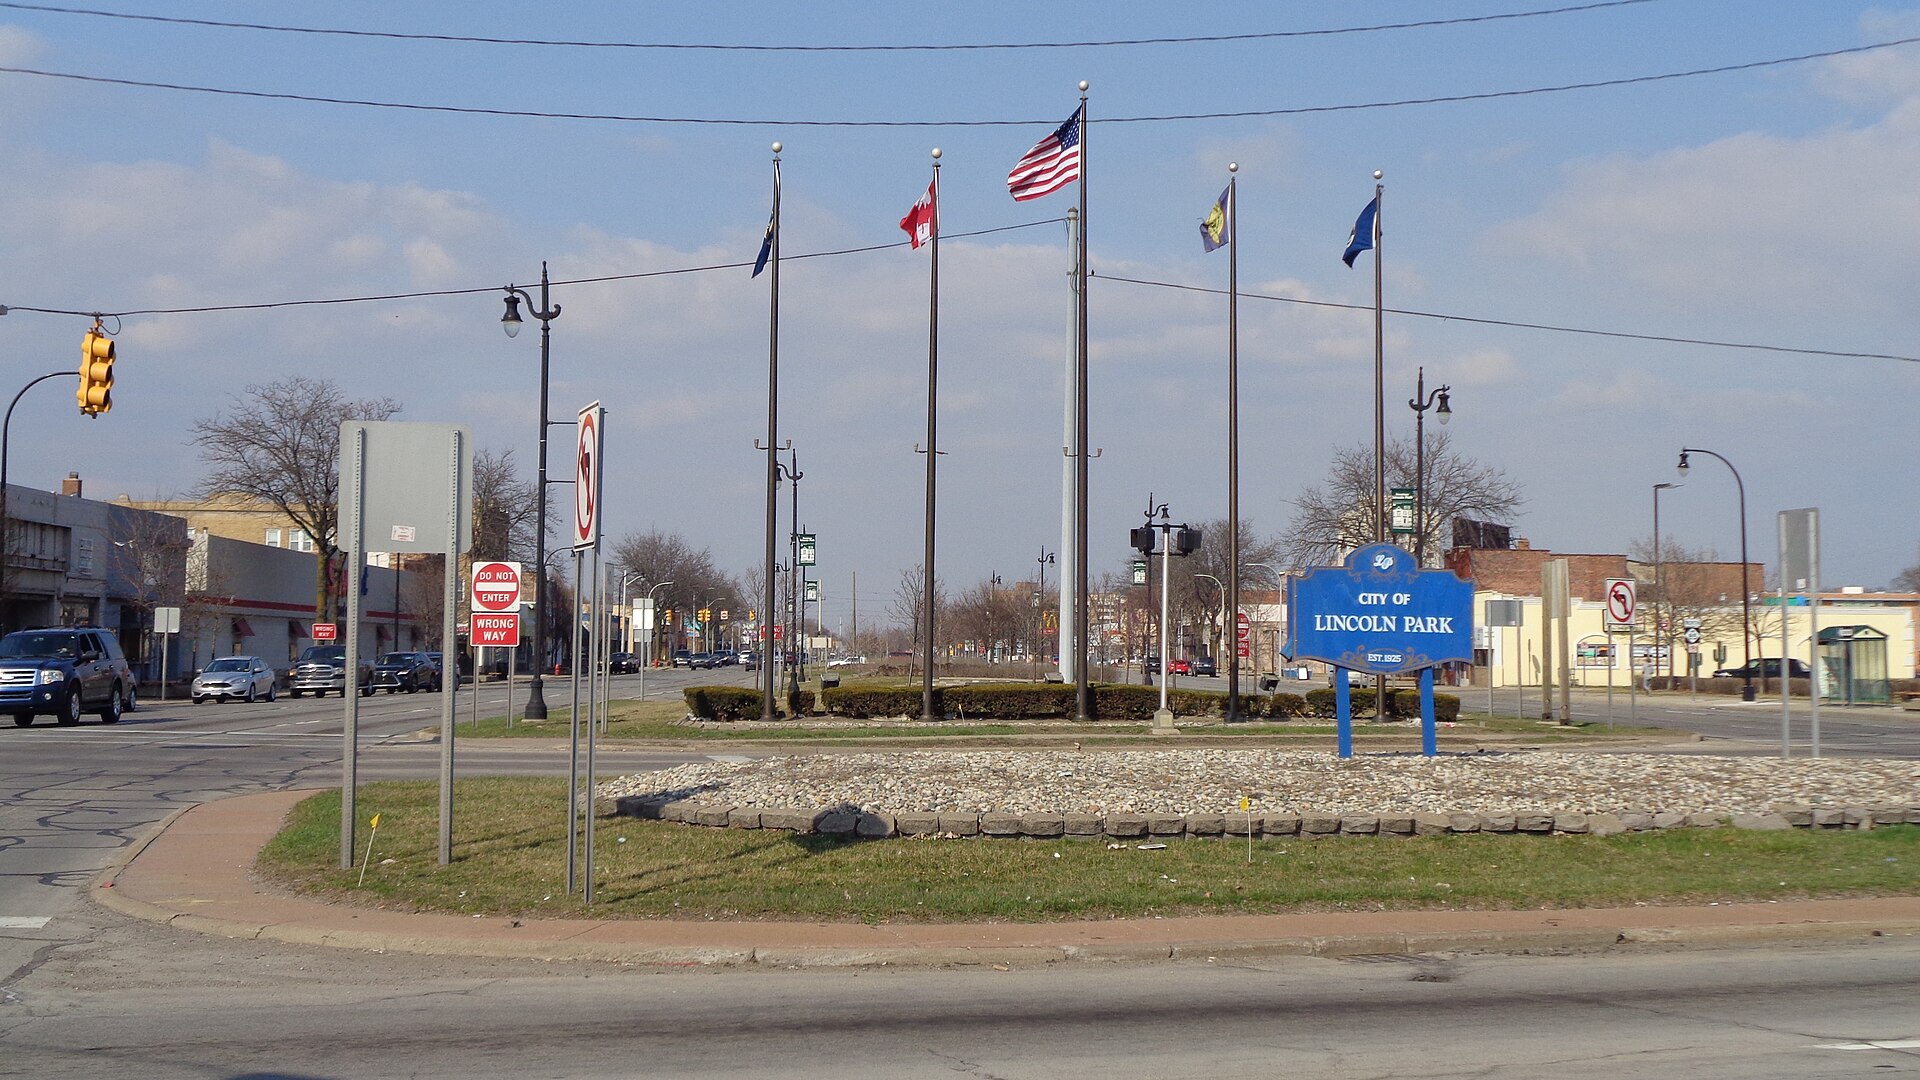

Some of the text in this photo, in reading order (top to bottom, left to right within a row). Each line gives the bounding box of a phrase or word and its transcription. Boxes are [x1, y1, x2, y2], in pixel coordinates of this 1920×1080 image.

[479, 571, 514, 580] DO NOT
[482, 593, 510, 602] ENTER
[1358, 593, 1411, 606] CITY OF
[476, 618, 514, 629] WRONG
[1315, 614, 1454, 633] LINCOLN PARK
[483, 631, 506, 641] WAY
